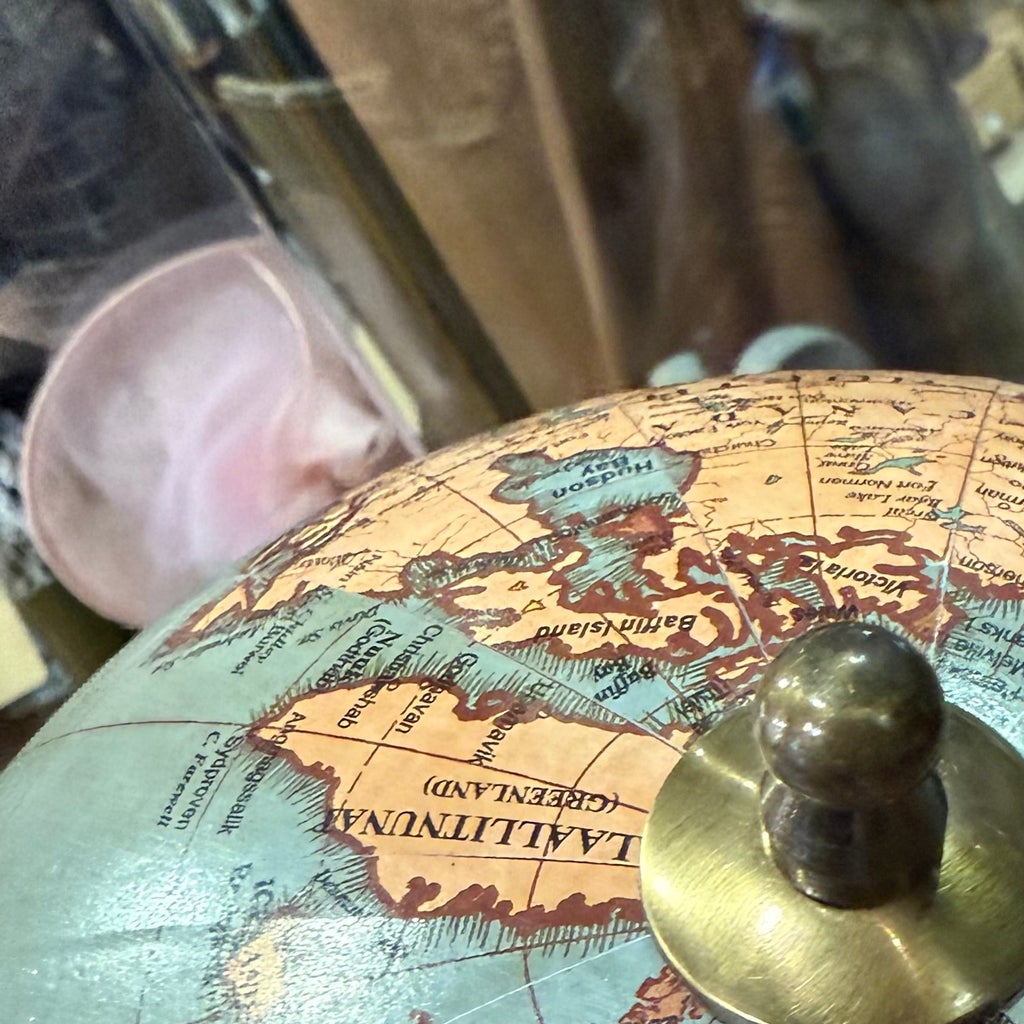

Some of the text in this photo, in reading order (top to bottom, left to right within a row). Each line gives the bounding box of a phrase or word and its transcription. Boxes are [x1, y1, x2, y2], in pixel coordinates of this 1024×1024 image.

[552, 460, 655, 498] Hudson
[824, 563, 907, 599] Victoria
[536, 614, 699, 640] Baffin Island
[423, 774, 620, 815] (GREENLAND)
